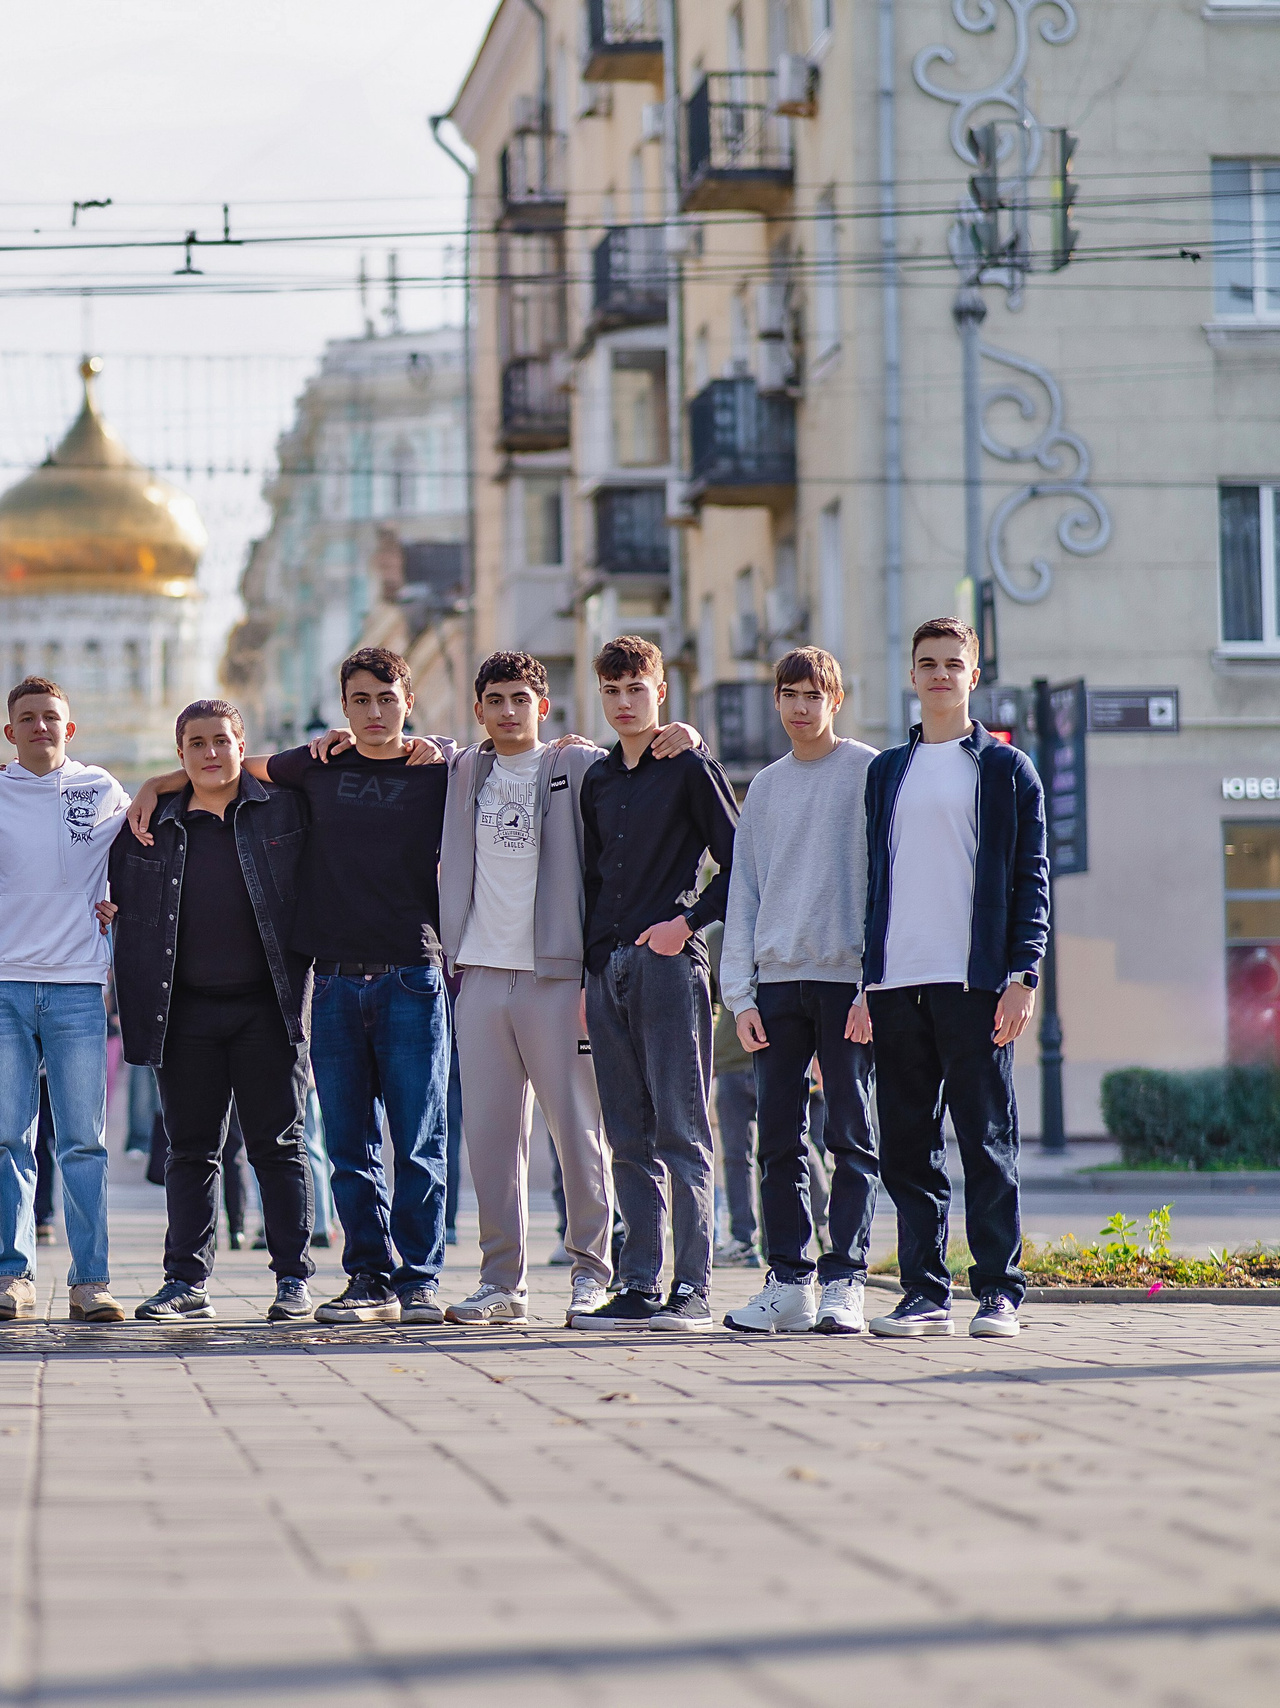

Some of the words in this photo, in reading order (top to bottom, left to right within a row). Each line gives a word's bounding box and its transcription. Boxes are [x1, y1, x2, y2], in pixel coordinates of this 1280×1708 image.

[337, 772, 408, 802] EA7
[551, 780, 566, 788] HUGO
[1222, 777, 1280, 799] юве
[70, 828, 94, 847] PARK
